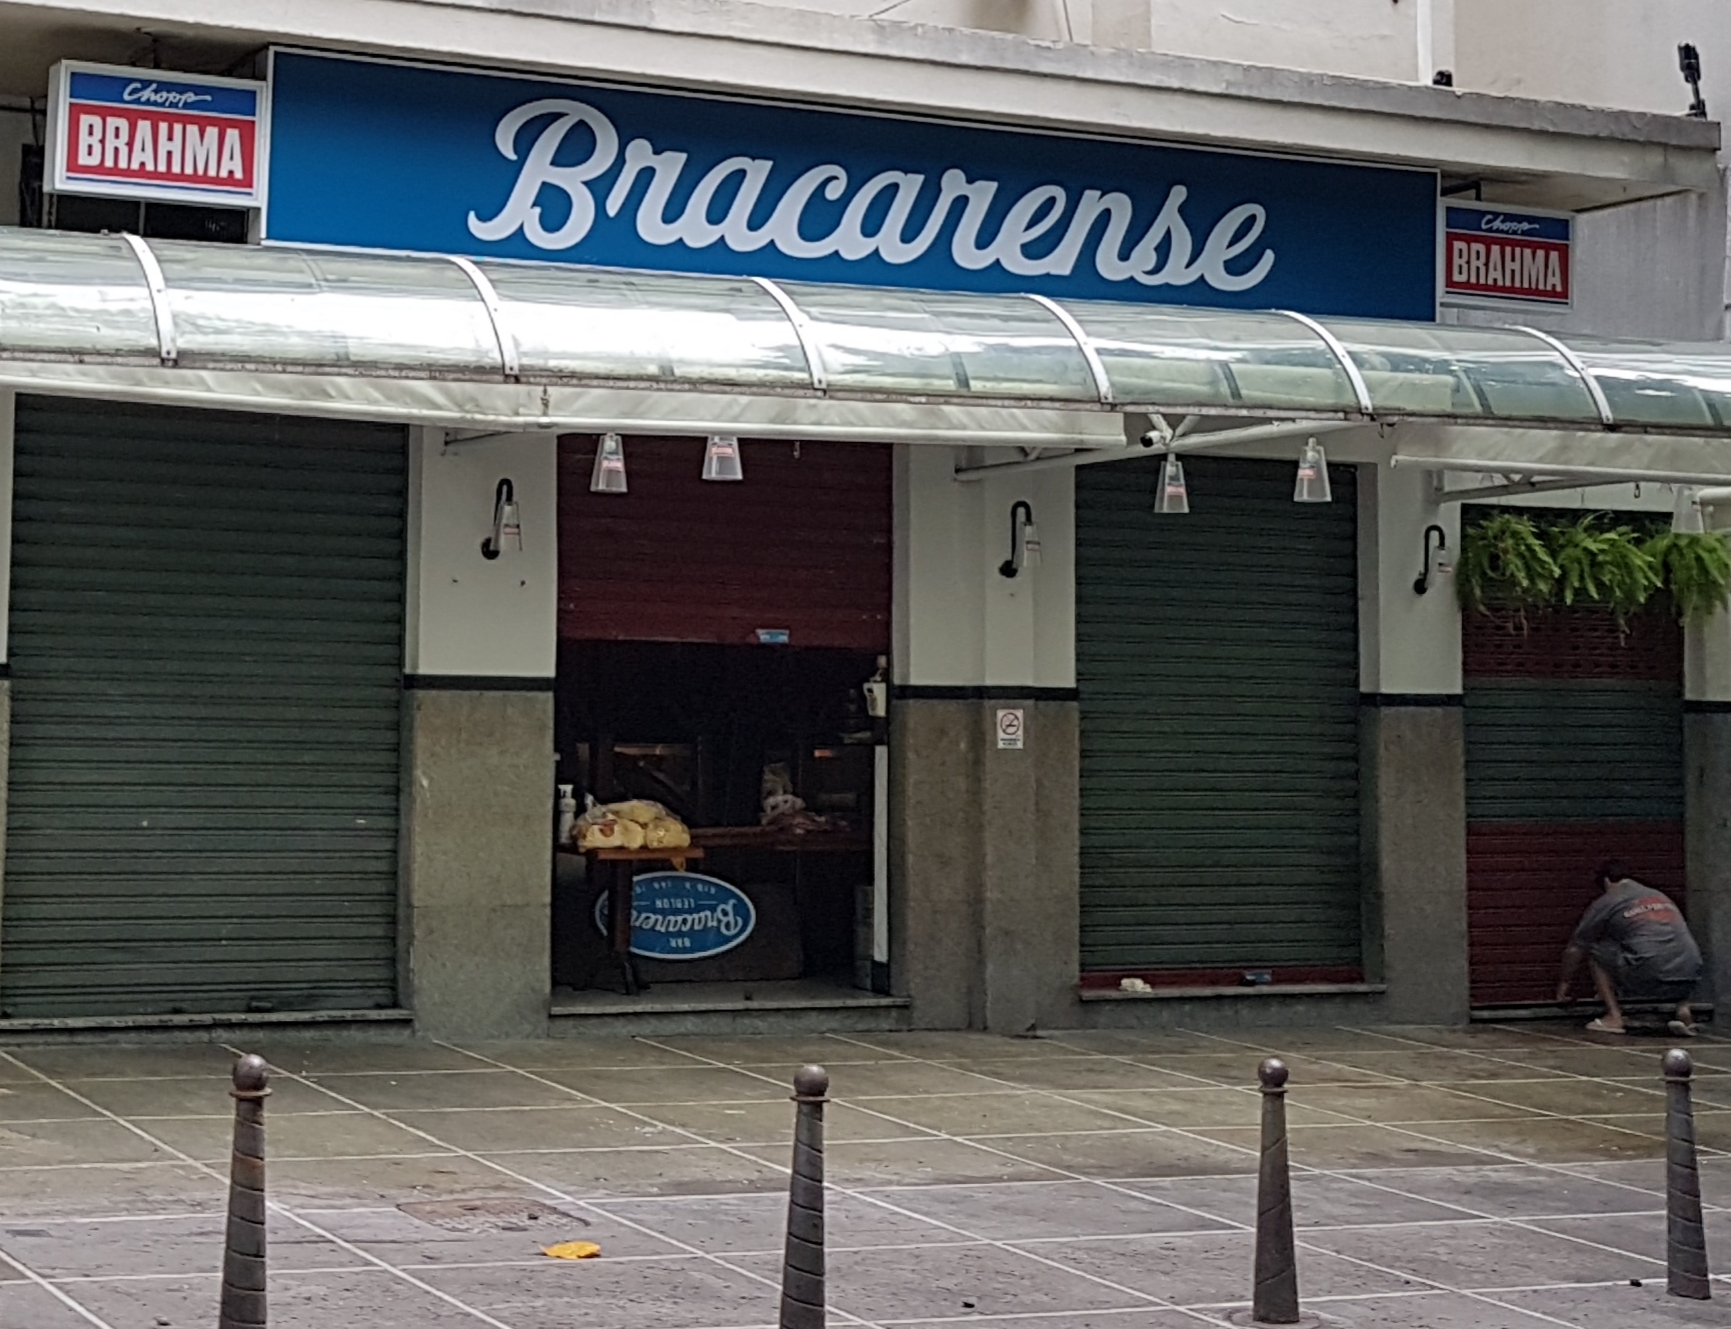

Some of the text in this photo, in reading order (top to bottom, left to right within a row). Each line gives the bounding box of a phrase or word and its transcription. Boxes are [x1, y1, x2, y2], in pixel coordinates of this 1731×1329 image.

[122, 82, 212, 108] Chopp
[77, 113, 244, 180] BRAHMA
[467, 98, 1275, 292] Bracarense
[1481, 214, 1540, 234] Chopp
[1452, 240, 1562, 292] BRAHMA
[631, 898, 744, 936] Bracaren
